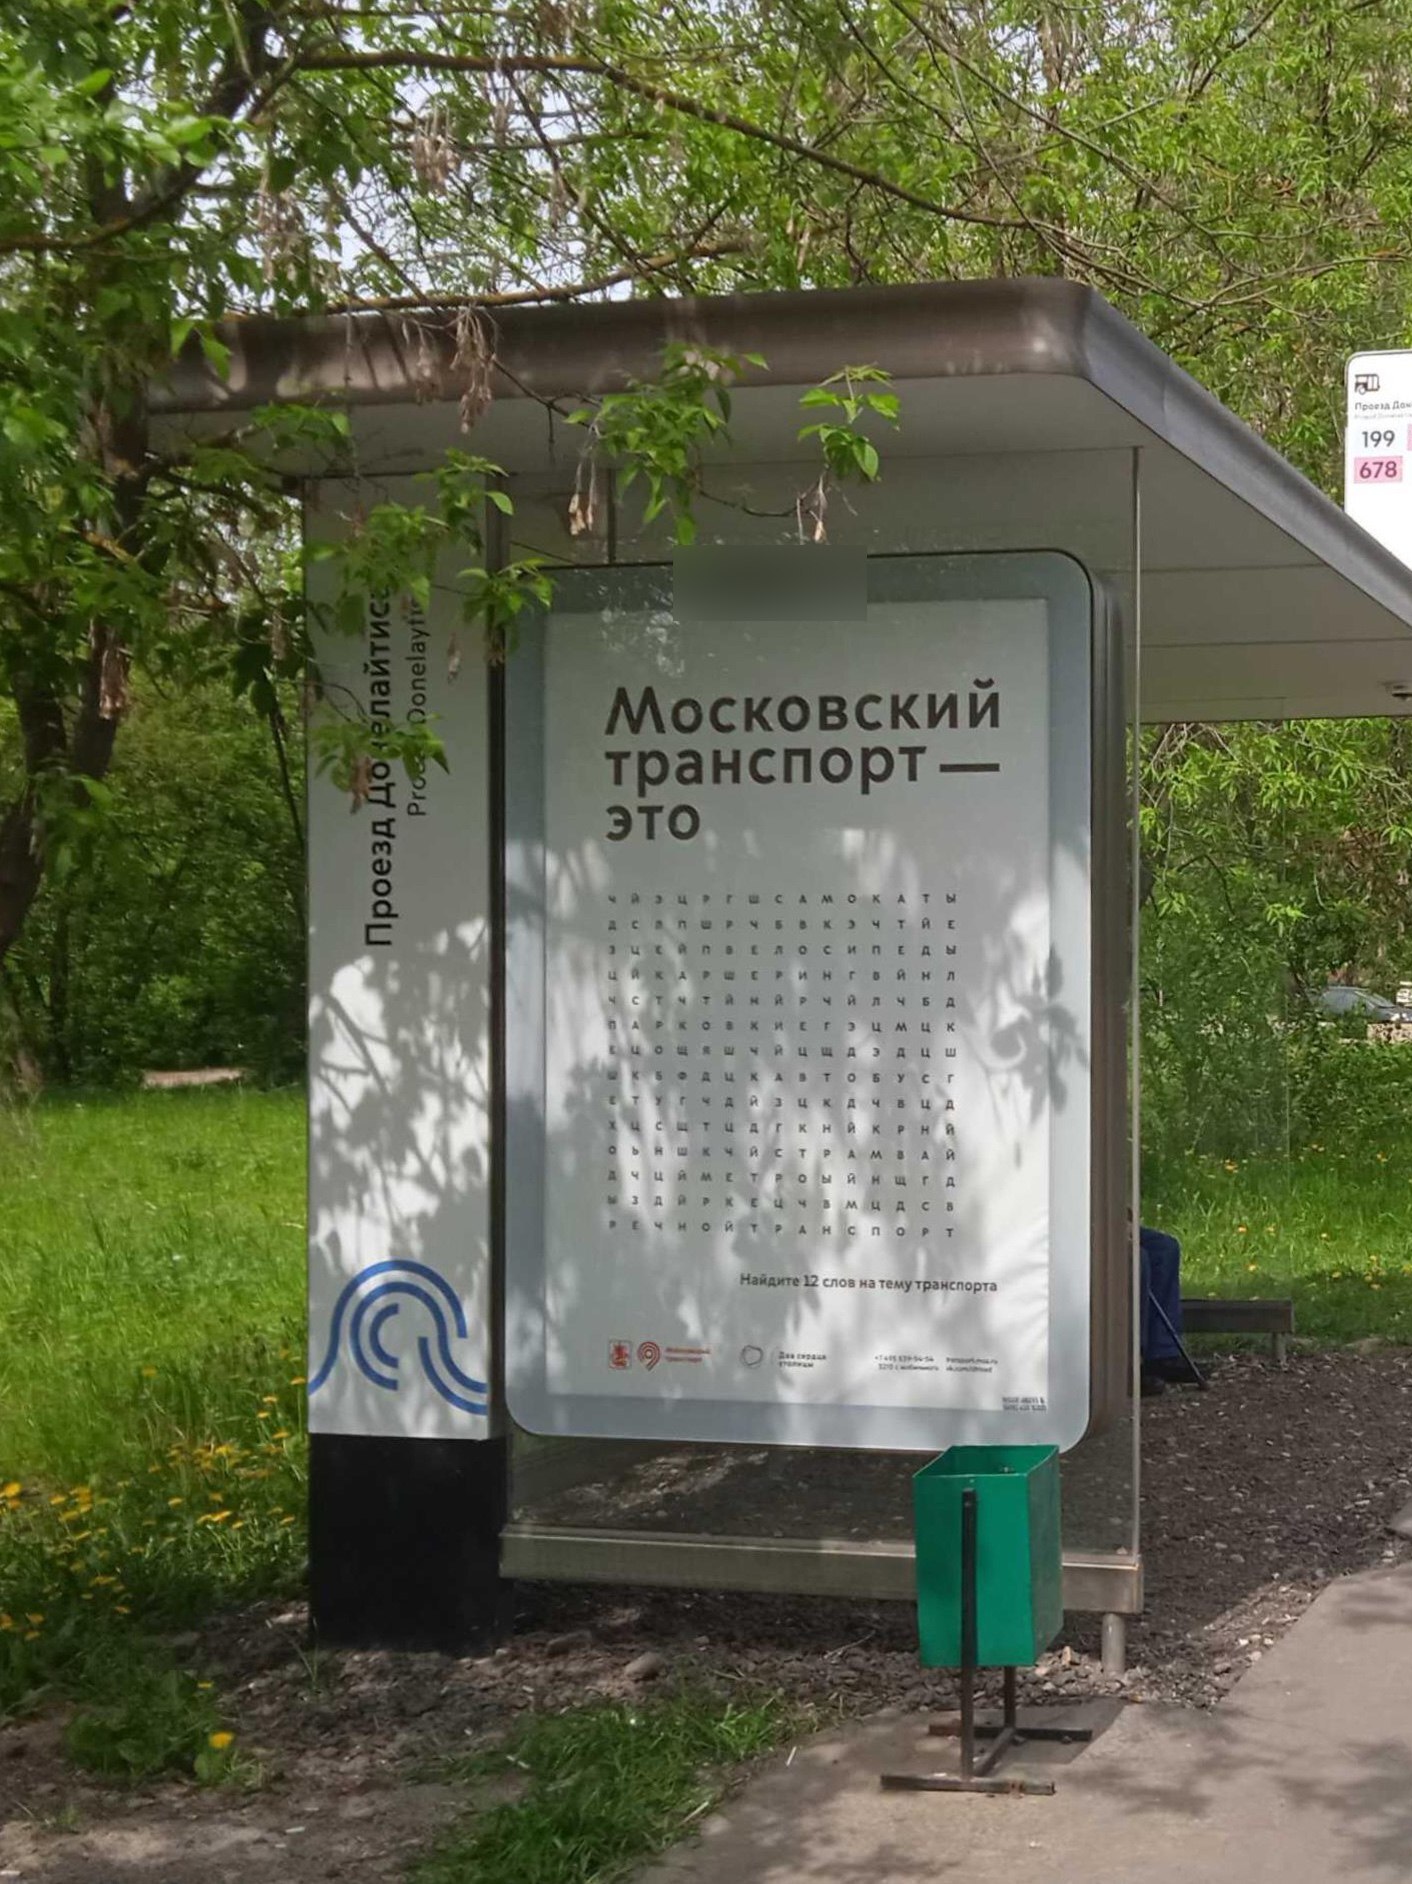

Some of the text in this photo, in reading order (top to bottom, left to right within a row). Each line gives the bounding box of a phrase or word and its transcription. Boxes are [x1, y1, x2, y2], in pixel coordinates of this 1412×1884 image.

[1361, 430, 1396, 448] 199
[1359, 460, 1398, 479] 678
[604, 677, 1000, 736] Московский
[362, 586, 399, 946] Проезд Доелайтис
[604, 745, 928, 798] транспорт
[605, 803, 701, 842] это
[739, 1273, 998, 1295] Найдите 12 слов на тему транспорта
